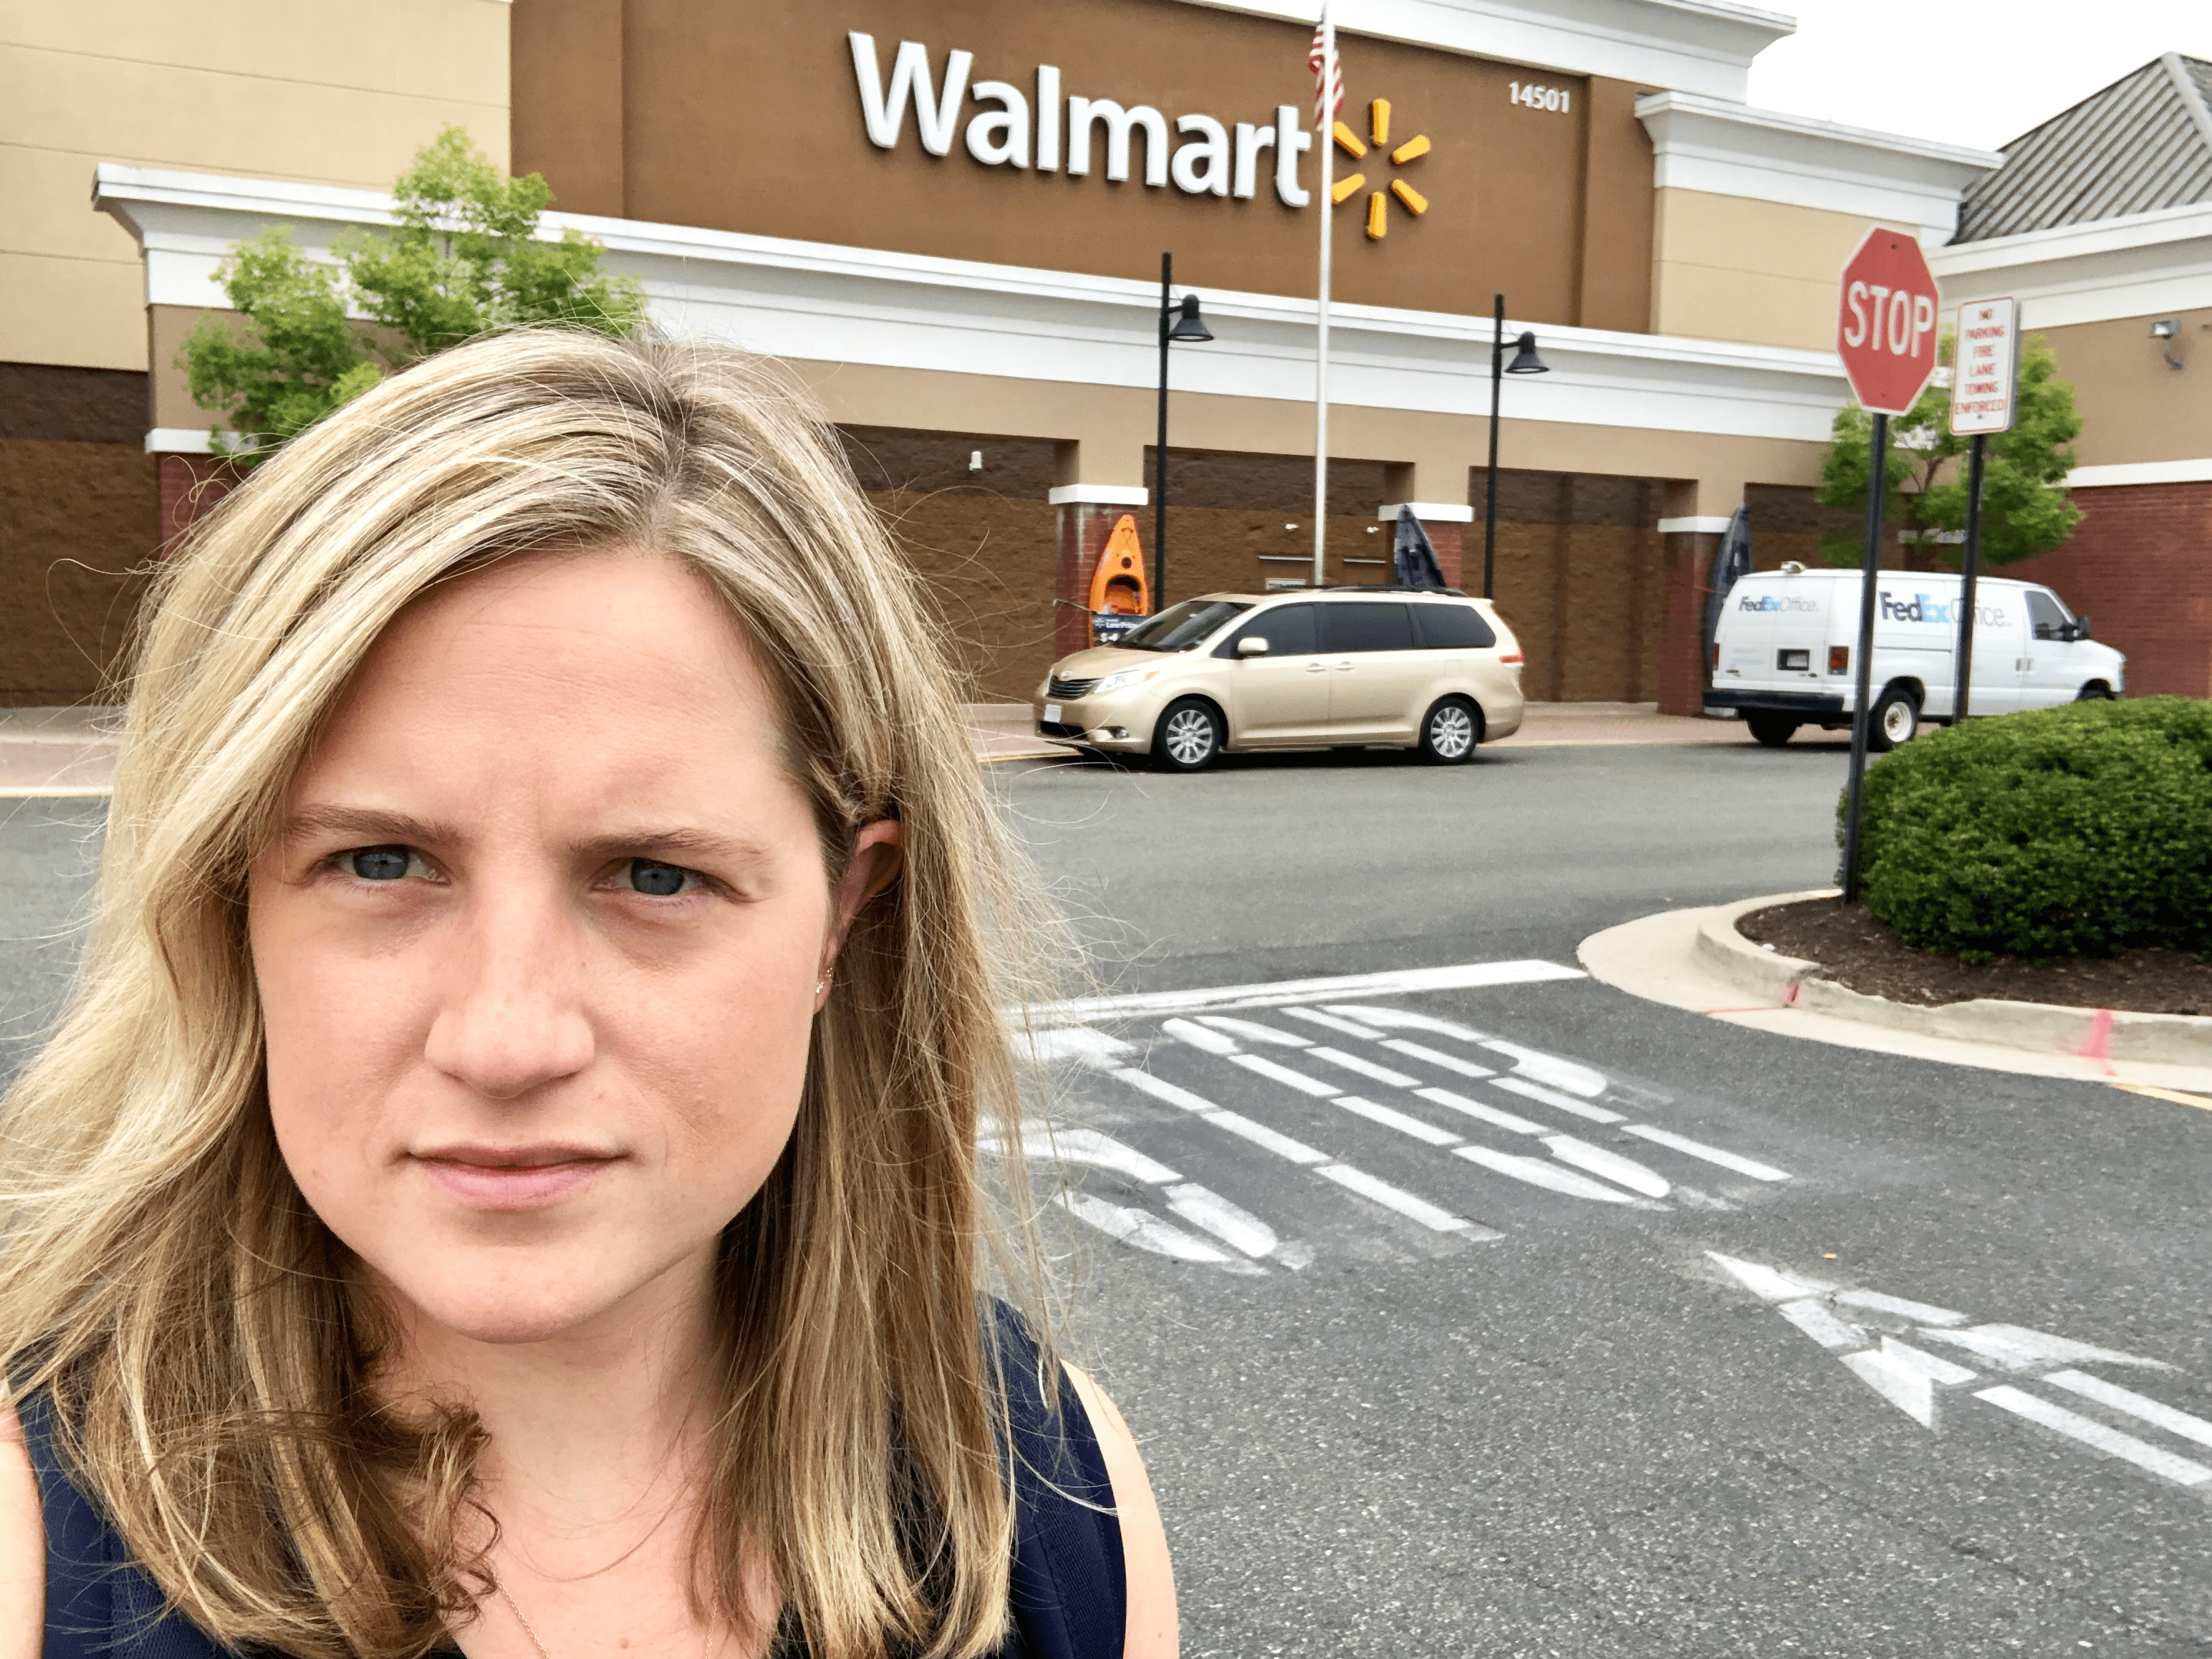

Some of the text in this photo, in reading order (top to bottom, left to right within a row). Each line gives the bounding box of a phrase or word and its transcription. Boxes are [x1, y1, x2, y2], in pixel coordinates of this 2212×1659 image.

[1509, 80, 1570, 114] 14501
[848, 30, 1311, 208] Walmart
[1844, 280, 1933, 358] STOP
[1965, 325, 2006, 341] PARKING
[1973, 345, 1995, 357] FIRE
[1968, 362, 1996, 377] LANE
[1965, 380, 1999, 395] TOWING
[1739, 595, 1817, 612] FedEx Office
[1879, 591, 1951, 624] FedEx
